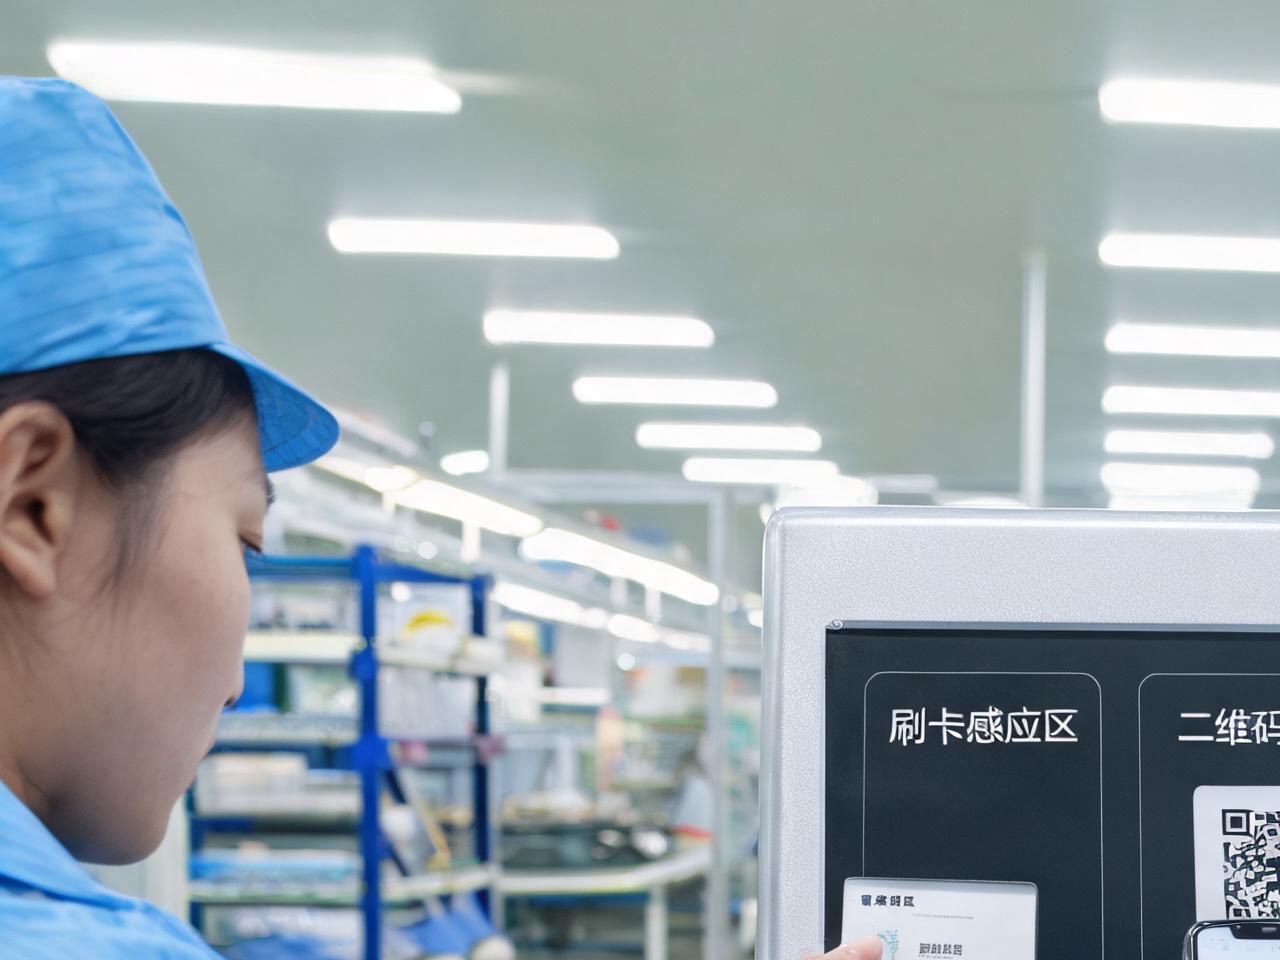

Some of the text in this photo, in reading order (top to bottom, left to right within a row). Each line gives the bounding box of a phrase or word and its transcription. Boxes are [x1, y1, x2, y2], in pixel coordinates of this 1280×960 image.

[887, 705, 1080, 748] 刷卡感应区
